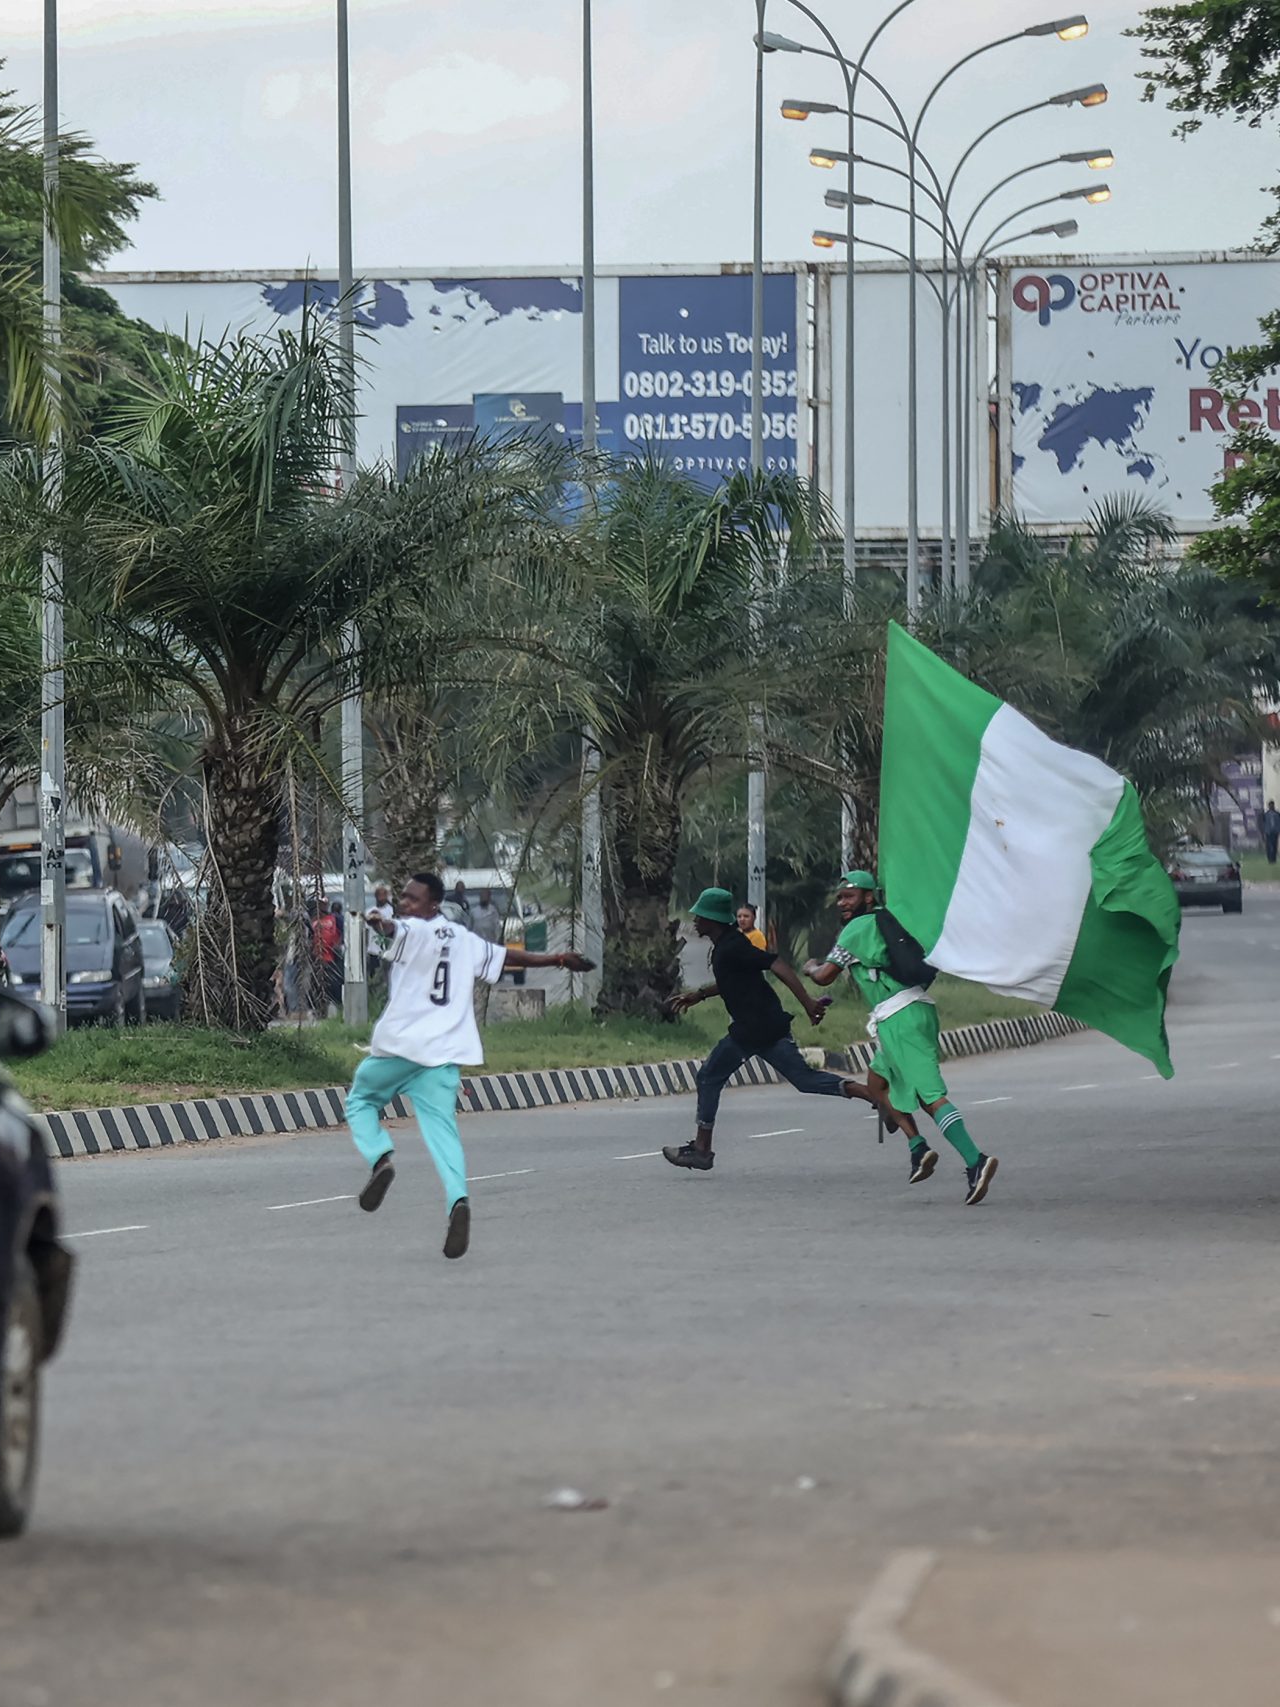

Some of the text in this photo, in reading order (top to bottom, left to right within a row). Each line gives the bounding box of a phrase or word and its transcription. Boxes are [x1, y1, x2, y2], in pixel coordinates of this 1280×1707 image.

[1079, 272, 1170, 292] OPTIVA
[1080, 292, 1181, 313] CAPITAL
[638, 331, 788, 359] Talk to us Toay!
[429, 960, 451, 1007] 9
